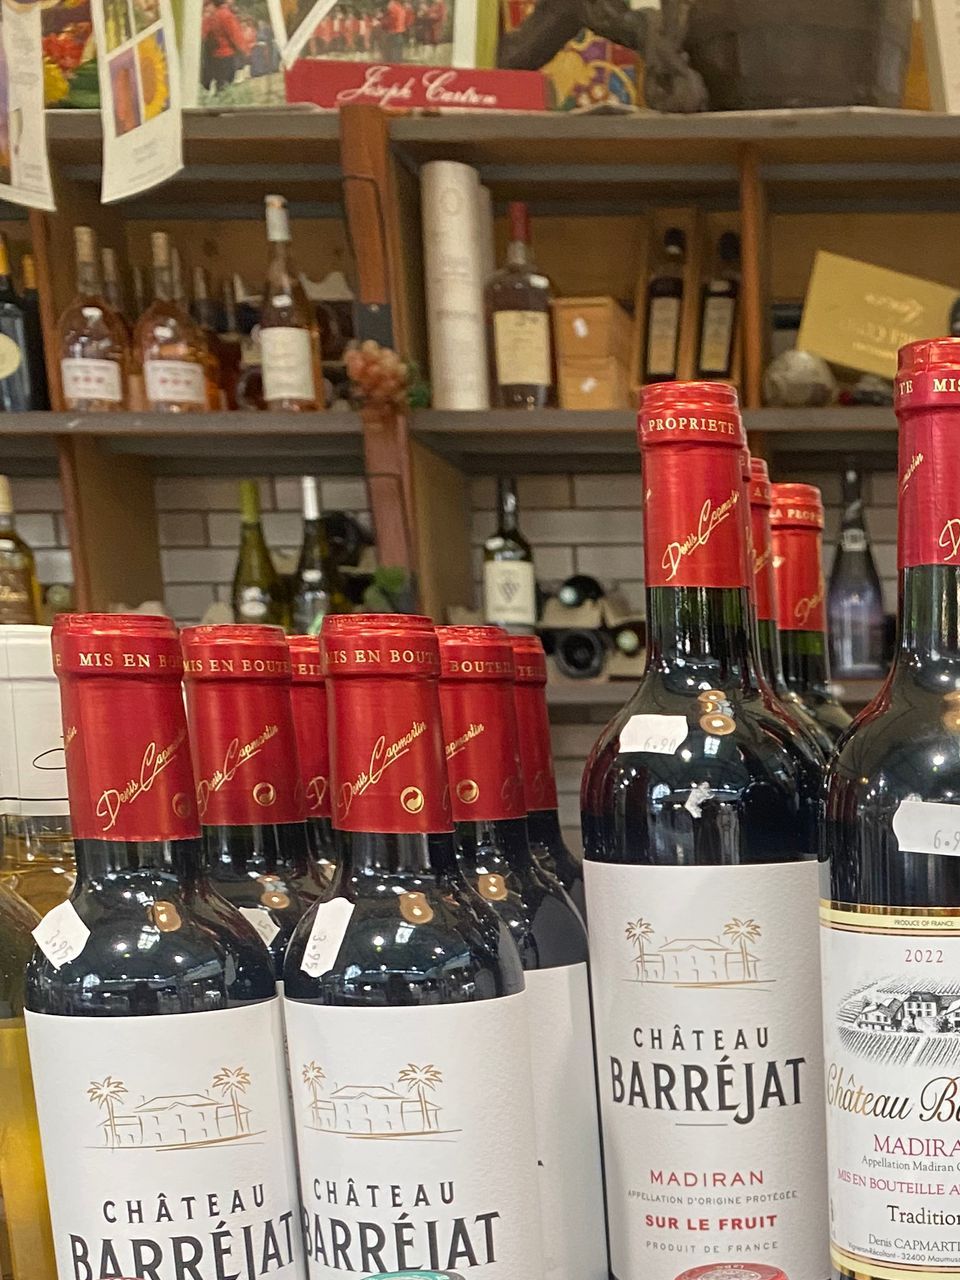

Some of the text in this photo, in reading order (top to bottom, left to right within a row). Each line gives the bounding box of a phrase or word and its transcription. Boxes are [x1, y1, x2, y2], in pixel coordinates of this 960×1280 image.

[648, 416, 735, 436] PROPRIETE
[79, 652, 151, 668] MIS EN
[354, 649, 381, 663] EN
[209, 659, 234, 672] EN
[904, 949, 944, 963] 2022
[633, 1024, 769, 1051] CHÂTEAU
[609, 1054, 807, 1125] BARRÉJAT
[826, 1063, 913, 1122] Château
[861, 1155, 911, 1171] Appellation
[912, 1158, 955, 1172] Madiran
[649, 1169, 764, 1188] MADIRAN
[837, 1168, 852, 1184] MIS
[852, 1175, 868, 1187] EN
[869, 1178, 945, 1196] BOUTEILLE
[314, 1177, 455, 1208] CHÂTEAU
[627, 1189, 798, 1206] APPELLATION D'ORIGINE PROTÉGÉE
[102, 1183, 264, 1224] CHÂTEAU
[645, 1214, 778, 1231] SUR LE FRUIT
[646, 1240, 779, 1254] PRODUIT DE FRANCE
[868, 1233, 892, 1248] Denis
[901, 1253, 926, 1262] 32400
